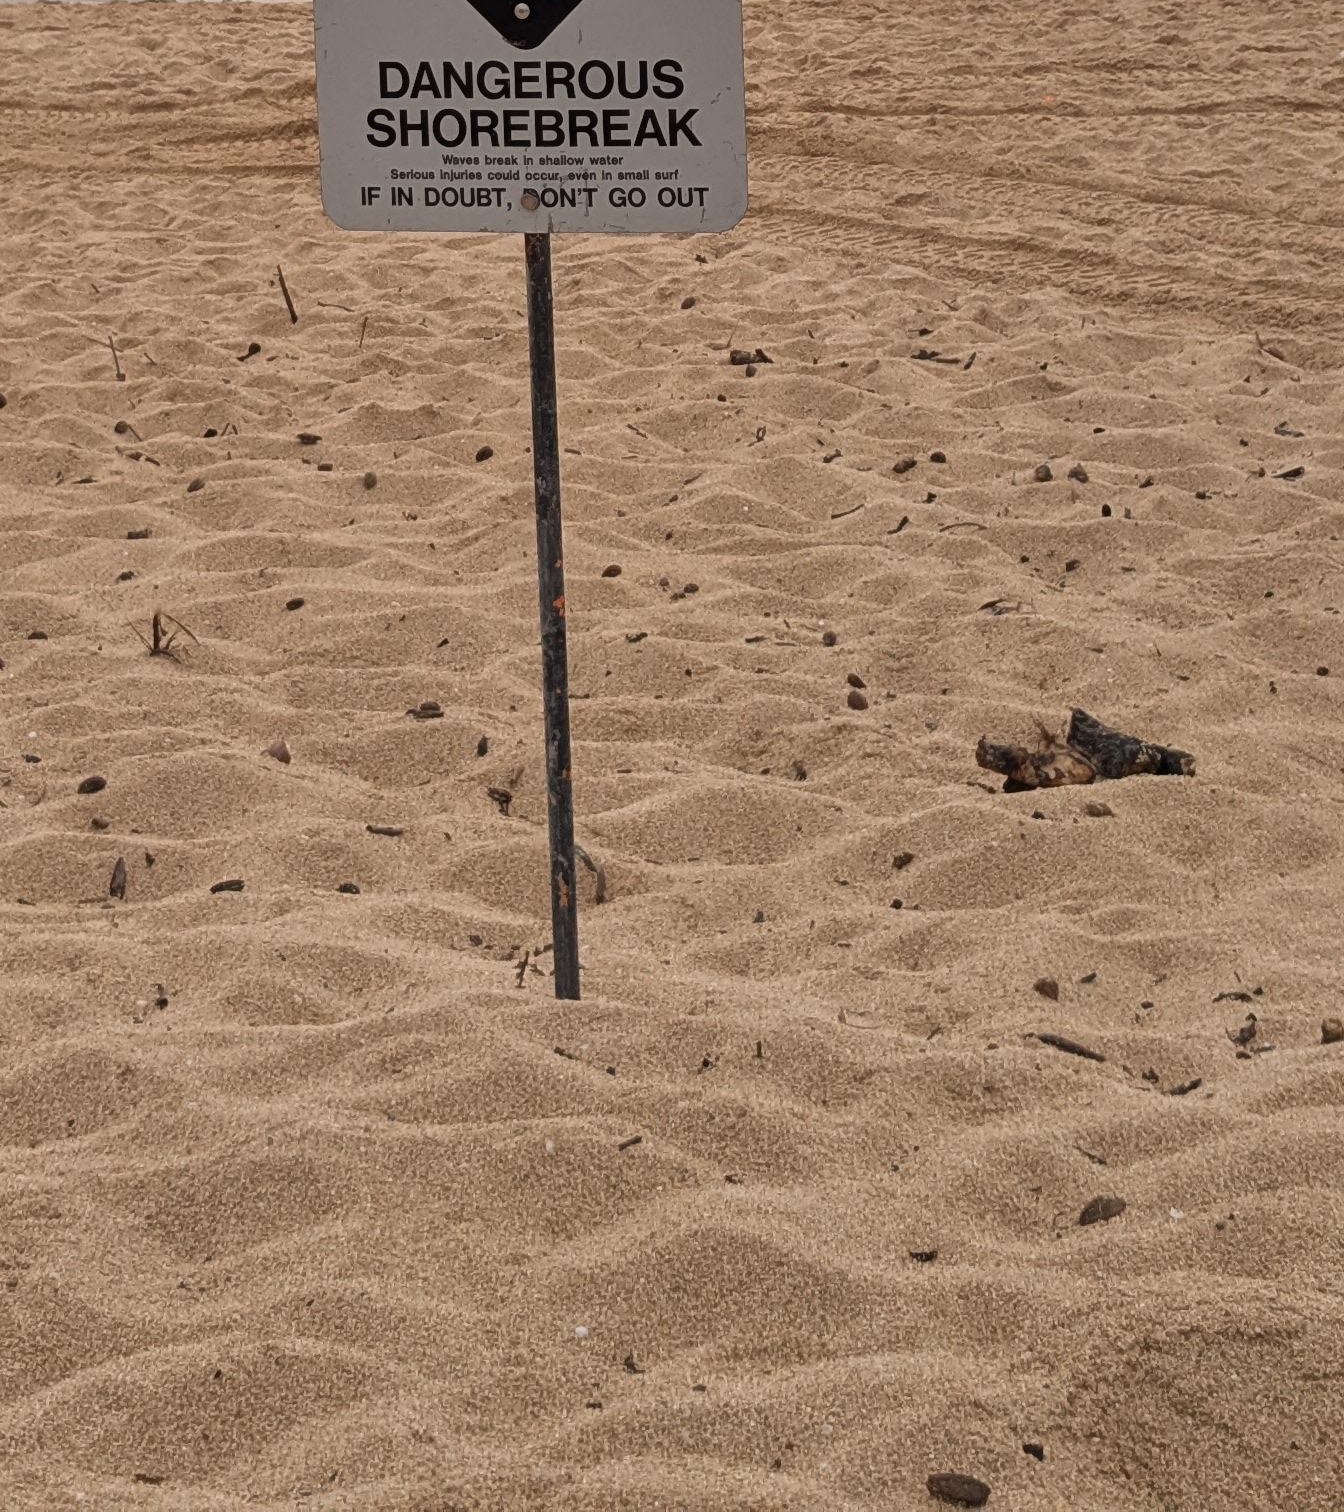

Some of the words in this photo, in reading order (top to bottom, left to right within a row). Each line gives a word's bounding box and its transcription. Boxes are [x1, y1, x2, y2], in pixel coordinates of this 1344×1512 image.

[379, 59, 684, 99] DANGEROUS
[366, 108, 702, 147] SHOREBREAK
[442, 154, 479, 166] Waves
[485, 154, 518, 166] break
[523, 154, 533, 166] in
[539, 154, 584, 166] shallow
[589, 155, 623, 166] water
[391, 169, 435, 180] Serious
[440, 169, 482, 182] injuries
[487, 169, 520, 181] could
[525, 172, 563, 182] occur,
[568, 172, 596, 180] even
[602, 170, 612, 181] in
[618, 169, 649, 180] small
[655, 169, 679, 180] surf
[361, 187, 381, 205] IF
[391, 187, 413, 205] IN
[425, 187, 512, 211] DOUBT,
[609, 187, 646, 207] GO
[658, 187, 709, 207] OUT
